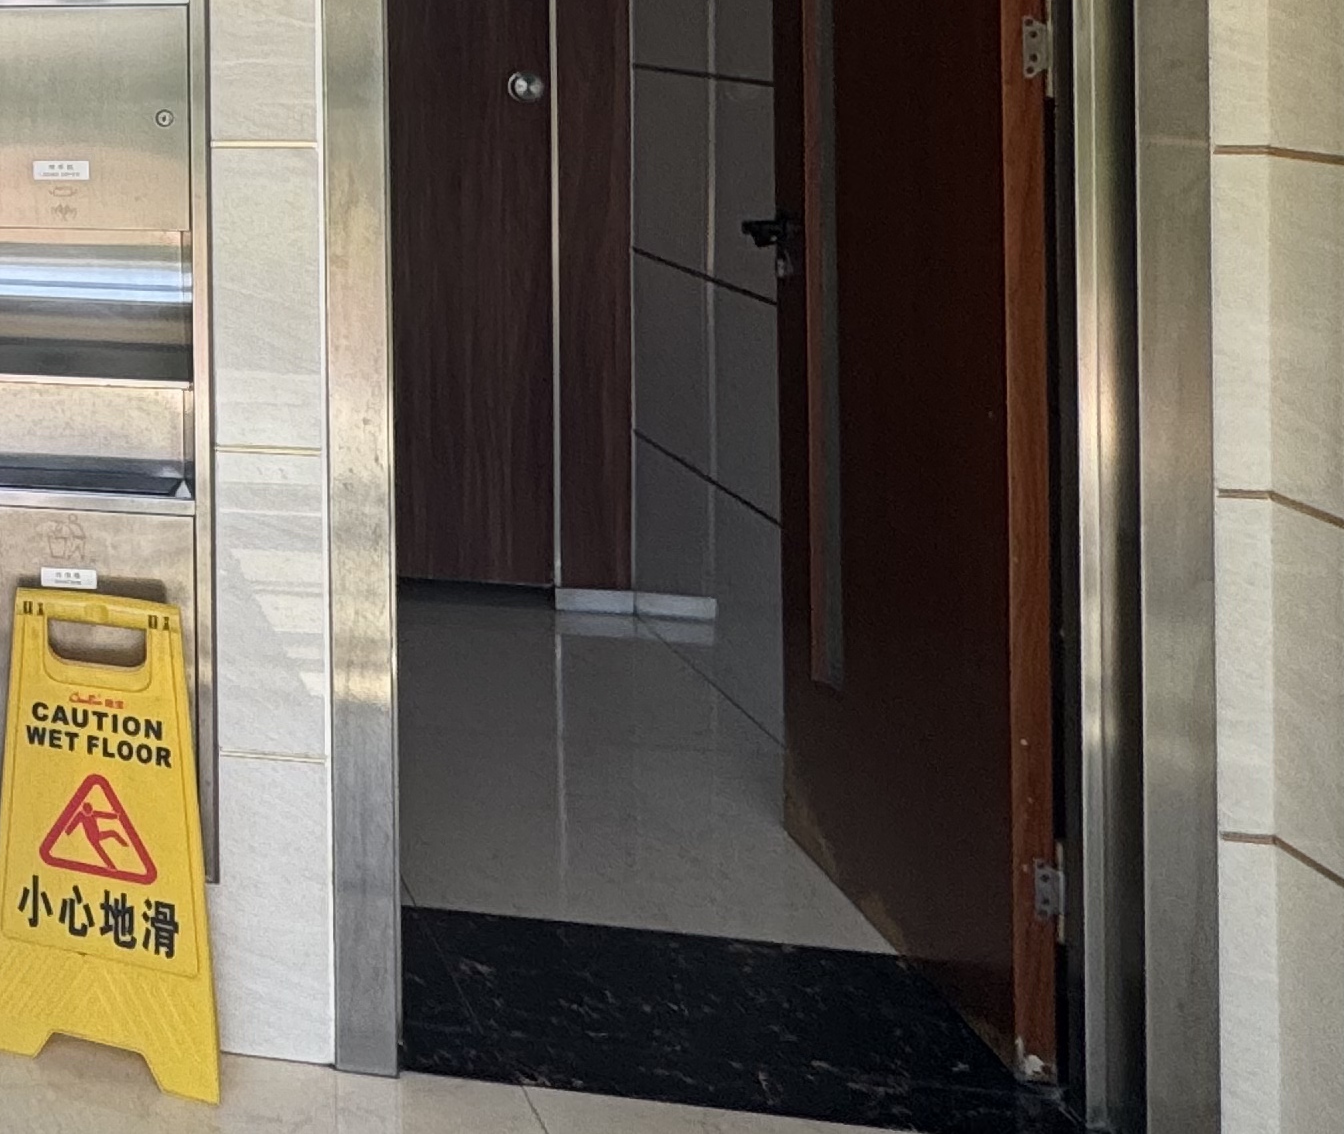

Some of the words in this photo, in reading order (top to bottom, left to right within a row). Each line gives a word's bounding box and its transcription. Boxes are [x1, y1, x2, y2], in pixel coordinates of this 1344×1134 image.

[32, 702, 163, 741] CAUTION
[25, 725, 79, 752] WET
[87, 735, 172, 768] FLOOR
[18, 875, 179, 959] 小心地滑
